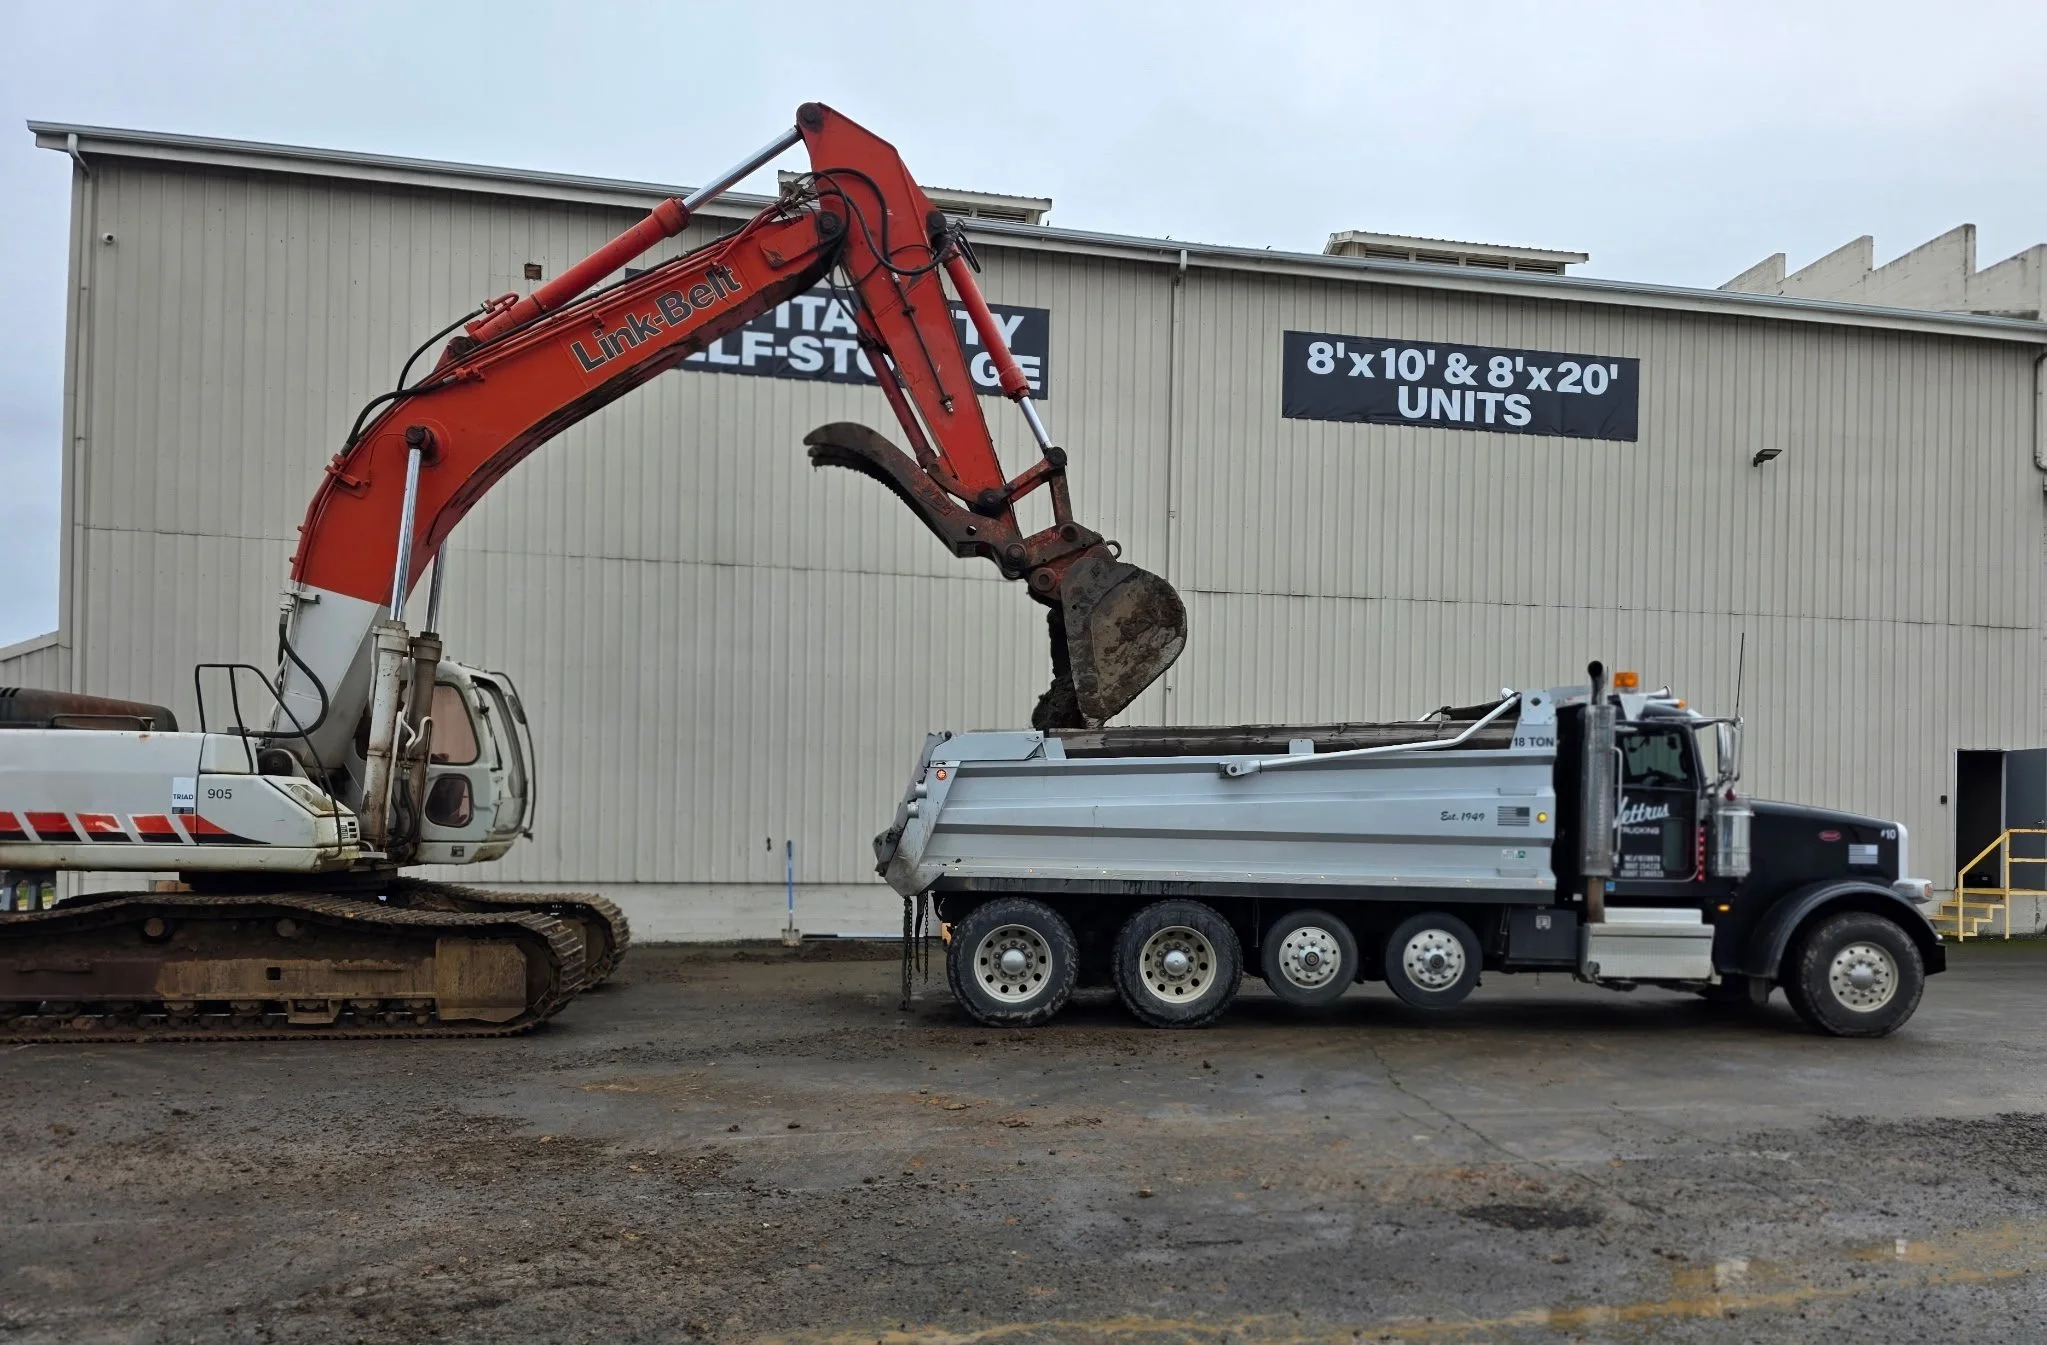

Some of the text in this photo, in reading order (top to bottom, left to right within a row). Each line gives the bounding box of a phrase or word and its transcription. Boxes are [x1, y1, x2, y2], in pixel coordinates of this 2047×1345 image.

[570, 264, 743, 374] Link-Belt
[1444, 352, 1479, 386] &
[1398, 385, 1532, 427] UNITS
[1514, 736, 1554, 747] 18 TON
[207, 788, 232, 799] 905
[1440, 810, 1485, 822] Est. 1949
[1880, 828, 1897, 840] #10
